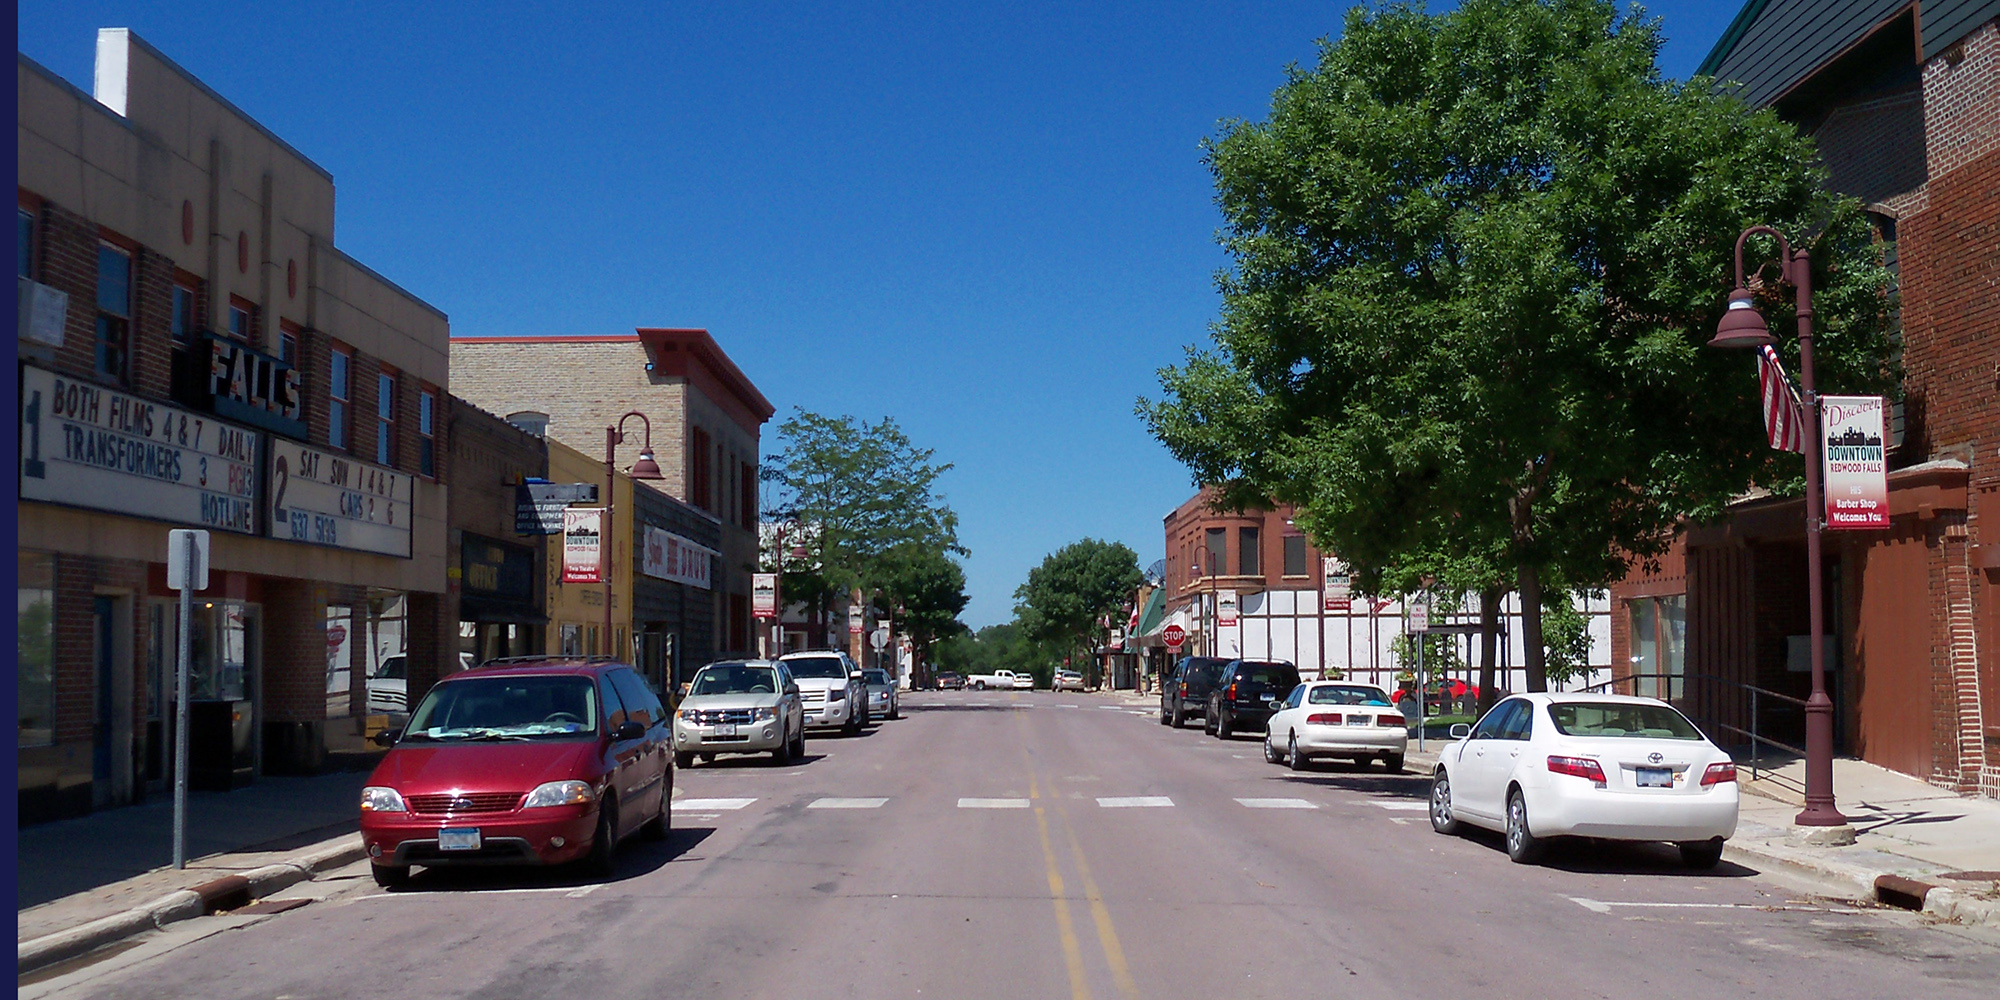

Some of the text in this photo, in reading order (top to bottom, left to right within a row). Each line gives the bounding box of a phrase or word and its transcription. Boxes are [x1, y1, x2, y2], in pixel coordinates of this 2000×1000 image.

[210, 339, 301, 421] FALLS
[54, 379, 255, 464] BOTH FILMS 4 & 7 DAILY
[1827, 399, 1881, 427] Discover
[25, 390, 45, 479] 1
[63, 423, 253, 497] TRANSFORMERS 3 PG13
[1828, 446, 1882, 461] DOWNTOWN
[1831, 463, 1881, 473] REDWOOD FALLS
[274, 454, 289, 523] 2
[301, 449, 320, 479] SAT
[331, 458, 350, 488] SUN
[358, 465, 364, 490] 1
[368, 469, 376, 493] 4
[388, 474, 395, 498] 7
[201, 492, 251, 531] HOTLINE
[340, 490, 364, 519] CARS
[1833, 512, 1882, 522] Welcomes You
[1836, 499, 1877, 510] Barber Shop
[566, 537, 599, 546] DOWNTOWN
[681, 546, 706, 581] DRUG
[1164, 631, 1184, 641] STOP
